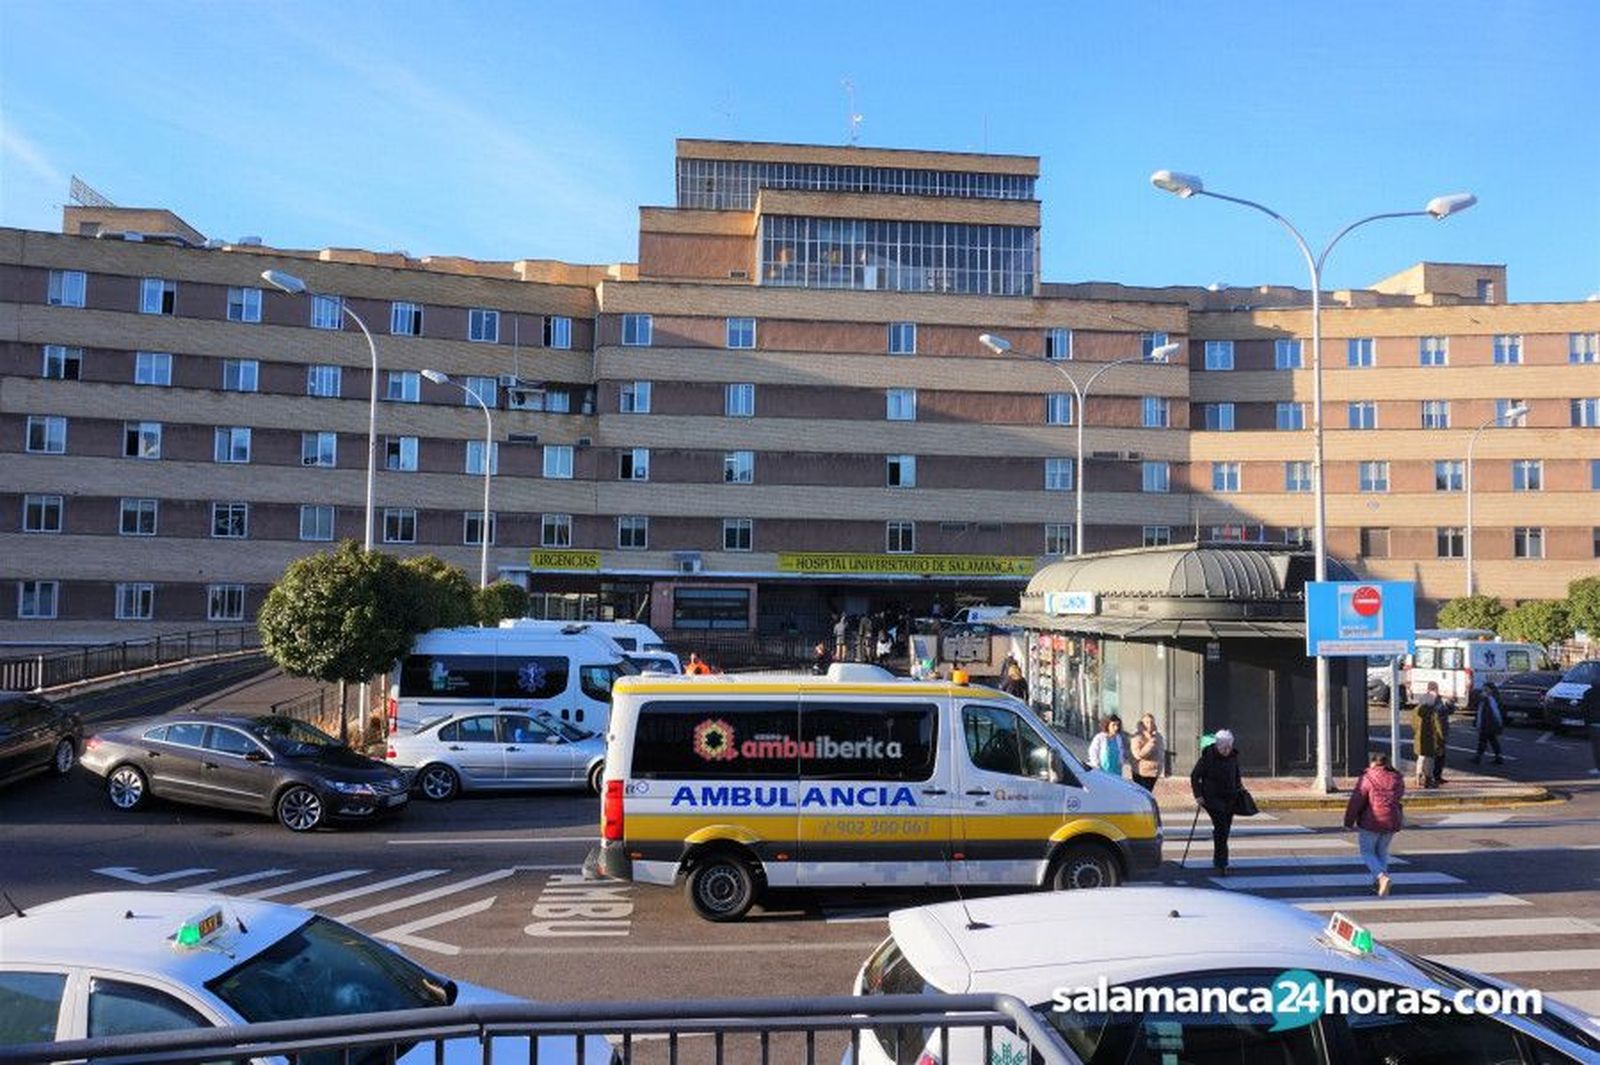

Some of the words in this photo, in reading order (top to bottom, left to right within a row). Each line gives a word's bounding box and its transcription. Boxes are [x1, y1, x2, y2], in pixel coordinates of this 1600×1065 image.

[533, 553, 598, 568] URGENCIAS
[797, 557, 846, 570] HOSPITAL
[849, 558, 929, 572] UNIVERSITARIO
[932, 559, 945, 572] DE
[948, 559, 1015, 573] SALAMANCA
[741, 735, 903, 760] ambuiberica
[671, 785, 918, 808] AMBULANCIA
